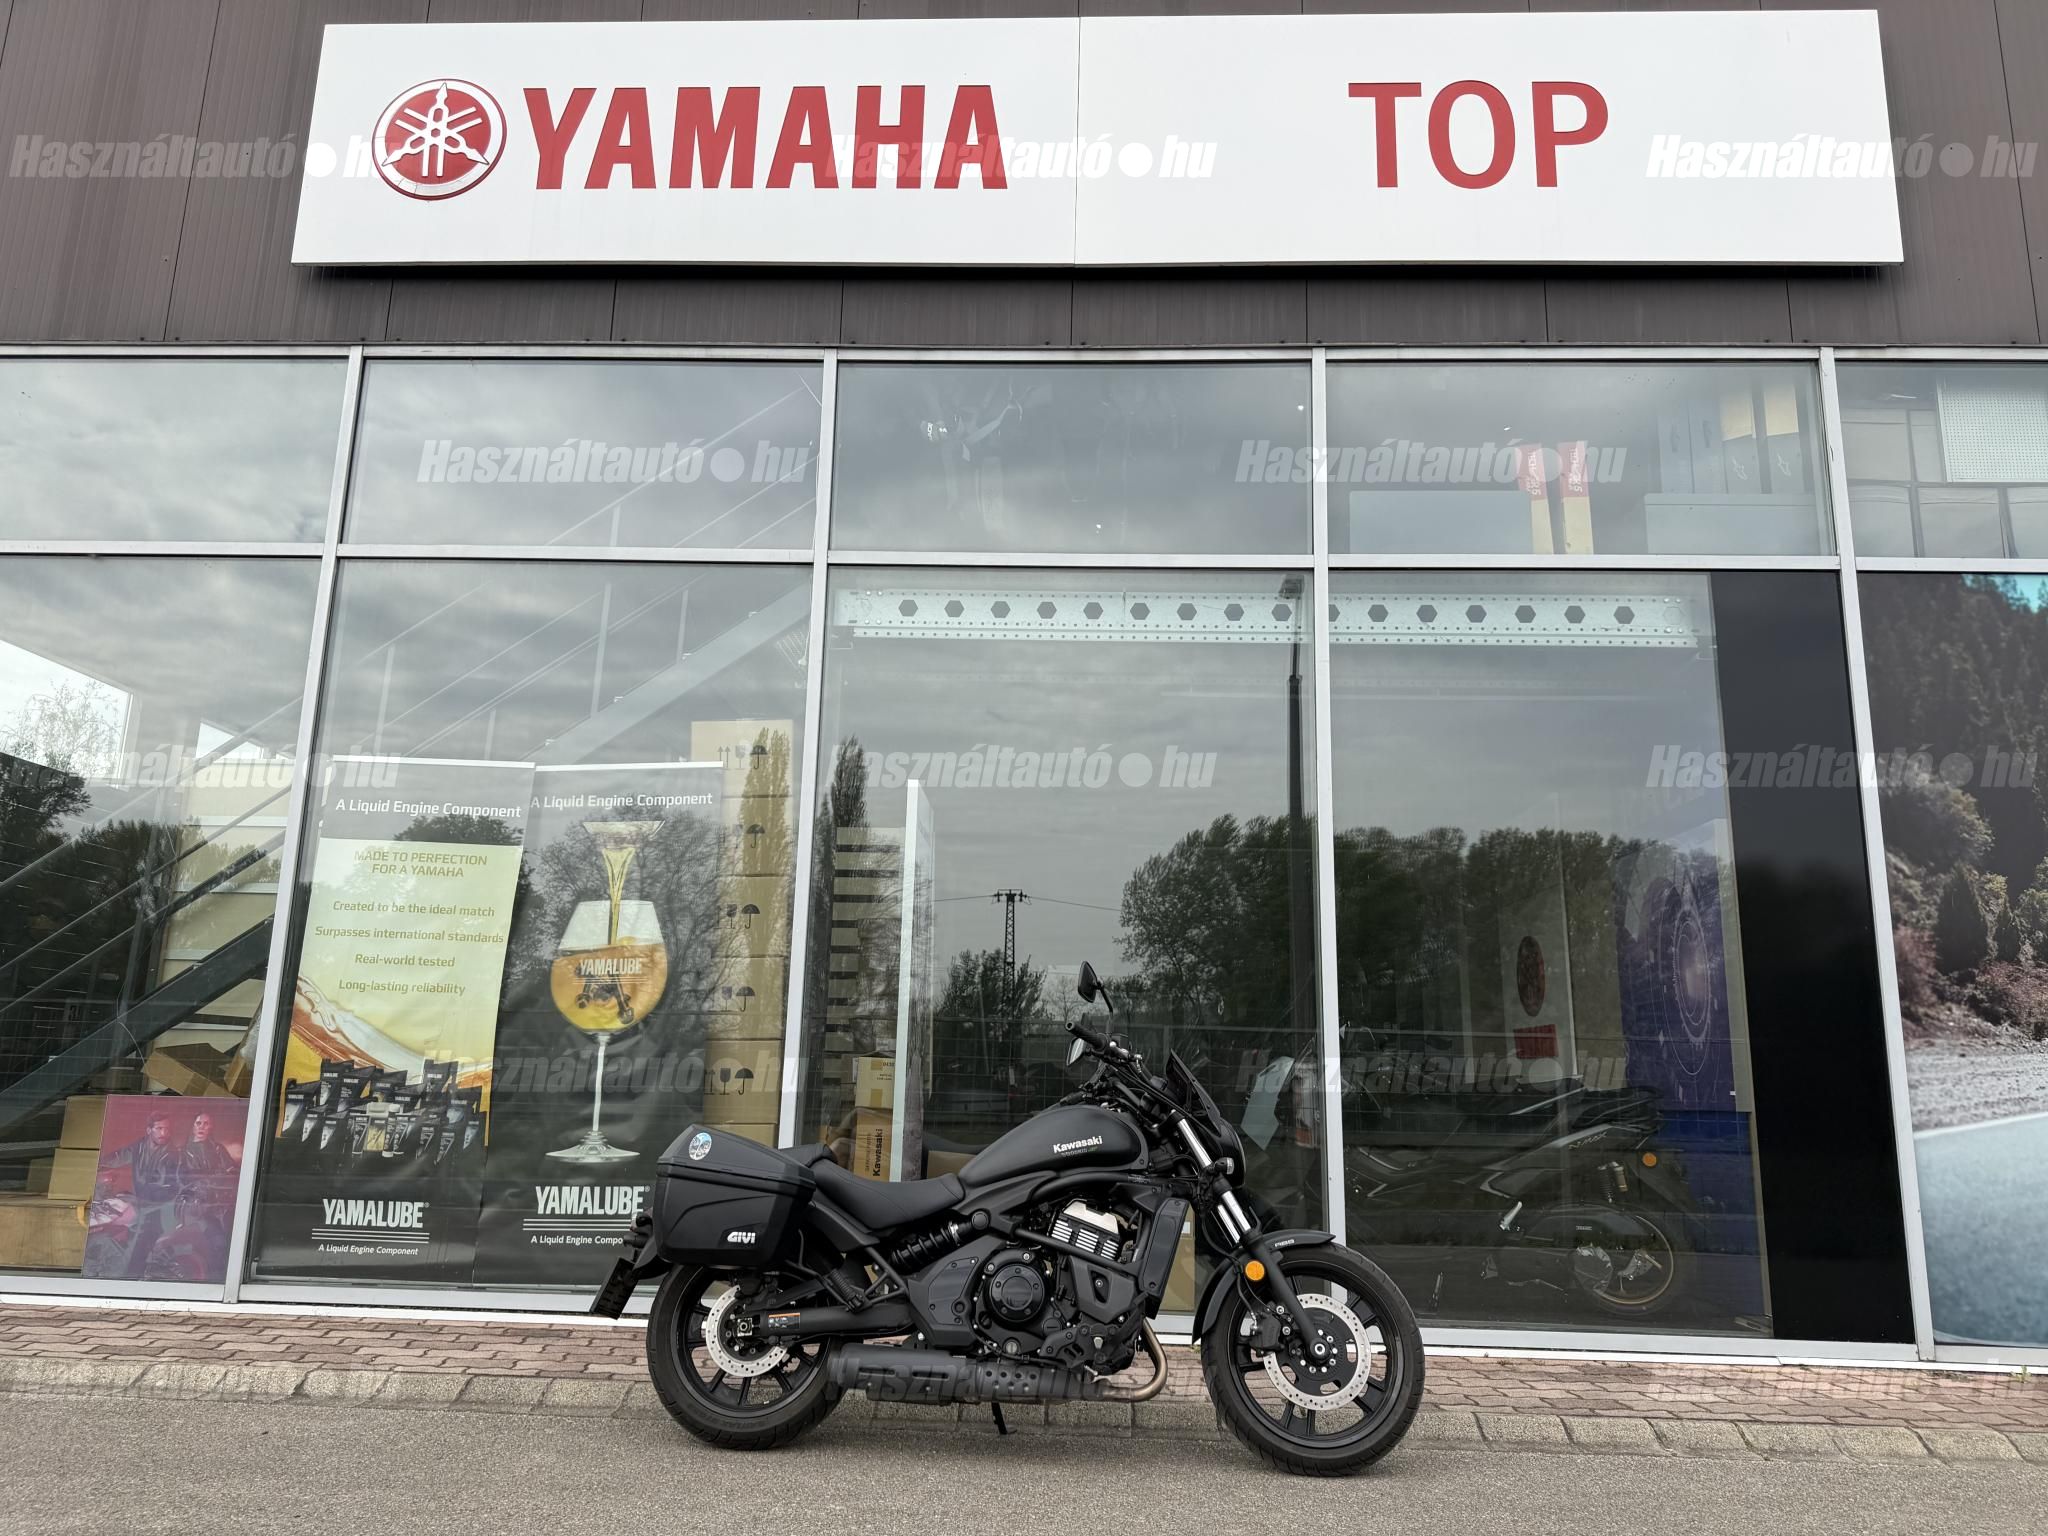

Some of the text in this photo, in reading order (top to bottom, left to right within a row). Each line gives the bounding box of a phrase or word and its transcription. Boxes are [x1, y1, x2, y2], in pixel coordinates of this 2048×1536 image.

[525, 80, 1607, 189] YAMAHA TOP
[336, 799, 521, 818] A Liquid Engine Component
[531, 792, 713, 810] A Liquid Engine Component
[355, 851, 487, 865] MADE TO PERFECTION
[372, 863, 464, 877] FOR A YAMAHA
[333, 901, 495, 917] Created to be the ideal match
[315, 926, 504, 943] Surpasses international standards
[355, 954, 456, 967] Real-world tested
[579, 958, 642, 976] YAMALUBE
[339, 979, 466, 996] Long-lasting reliability
[1053, 1136, 1103, 1153] Kawasaki
[530, 1235, 623, 1246] A Liquid Engine Compo
[727, 1231, 756, 1244] GIVI
[318, 1244, 419, 1256] A Liquid Engine Component
